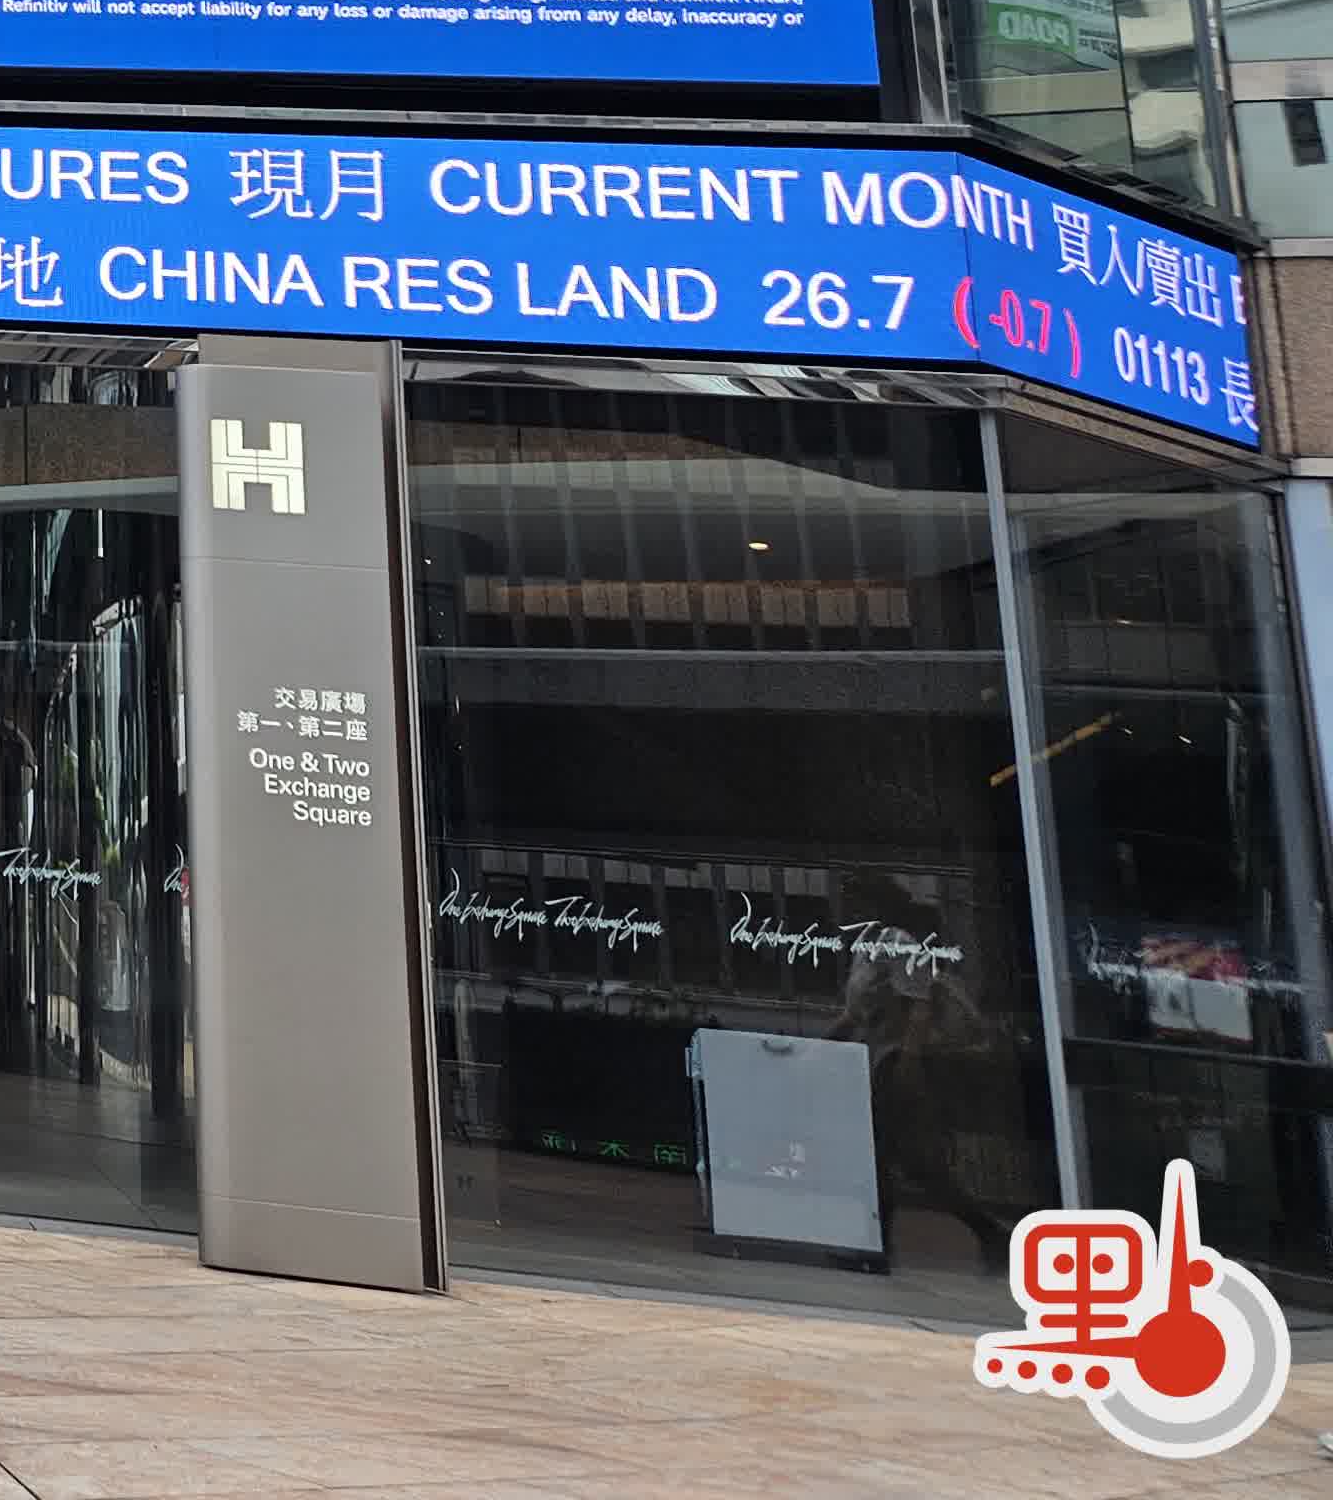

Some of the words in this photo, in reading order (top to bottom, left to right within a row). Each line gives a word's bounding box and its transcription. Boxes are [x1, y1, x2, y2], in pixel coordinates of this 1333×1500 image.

[229, 148, 383, 222] 現月
[430, 159, 799, 222] CURRENT
[822, 172, 1033, 250] MONTH
[1048, 199, 1222, 331] 買入/賣出
[100, 246, 324, 306] CHINA
[343, 256, 493, 314] RES
[517, 263, 717, 322] LAND
[762, 270, 914, 329] 26.7
[1114, 328, 1209, 405] 01113
[275, 688, 365, 714] 交易廣場
[237, 708, 367, 740] 第一、第二座
[249, 748, 294, 775] One
[301, 752, 319, 772] &
[323, 754, 369, 776] Two
[265, 772, 370, 804] Exchange
[294, 799, 371, 825] Square
